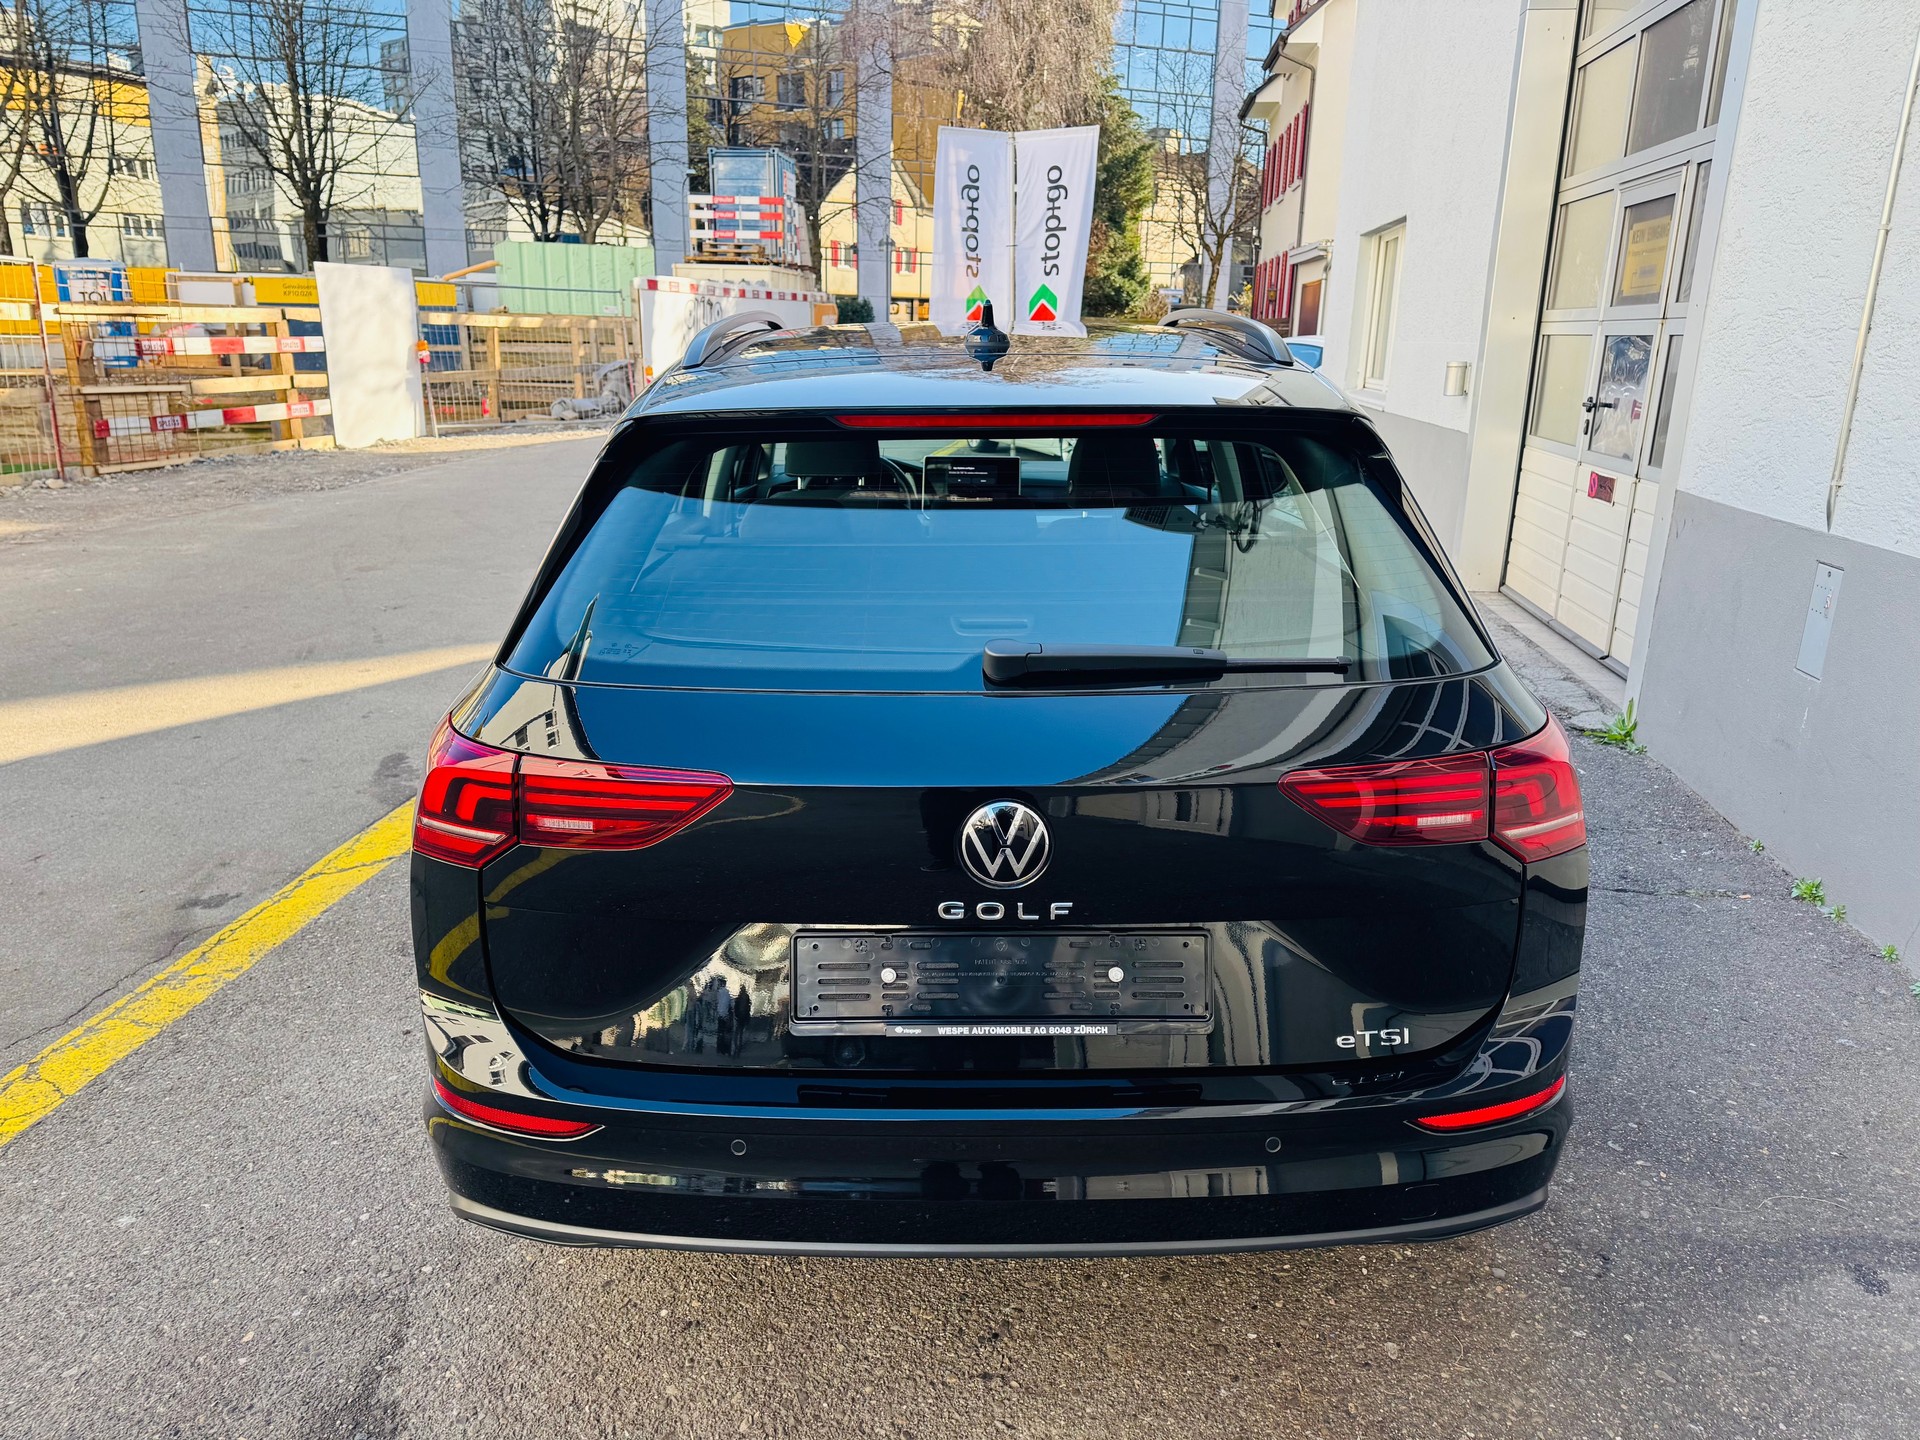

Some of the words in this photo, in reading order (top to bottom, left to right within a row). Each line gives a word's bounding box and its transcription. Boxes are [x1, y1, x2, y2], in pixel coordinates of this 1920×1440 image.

[1040, 164, 1069, 277] stop+go
[937, 901, 1074, 920] GOLF
[938, 1026, 969, 1035] WESPE
[971, 1026, 1032, 1035] AUTOMOBILE
[1033, 1026, 1047, 1035] AG
[1049, 1026, 1072, 1034] 8048
[1074, 1025, 1108, 1034] ZÜRICH
[1336, 1027, 1410, 1049] eTSI
